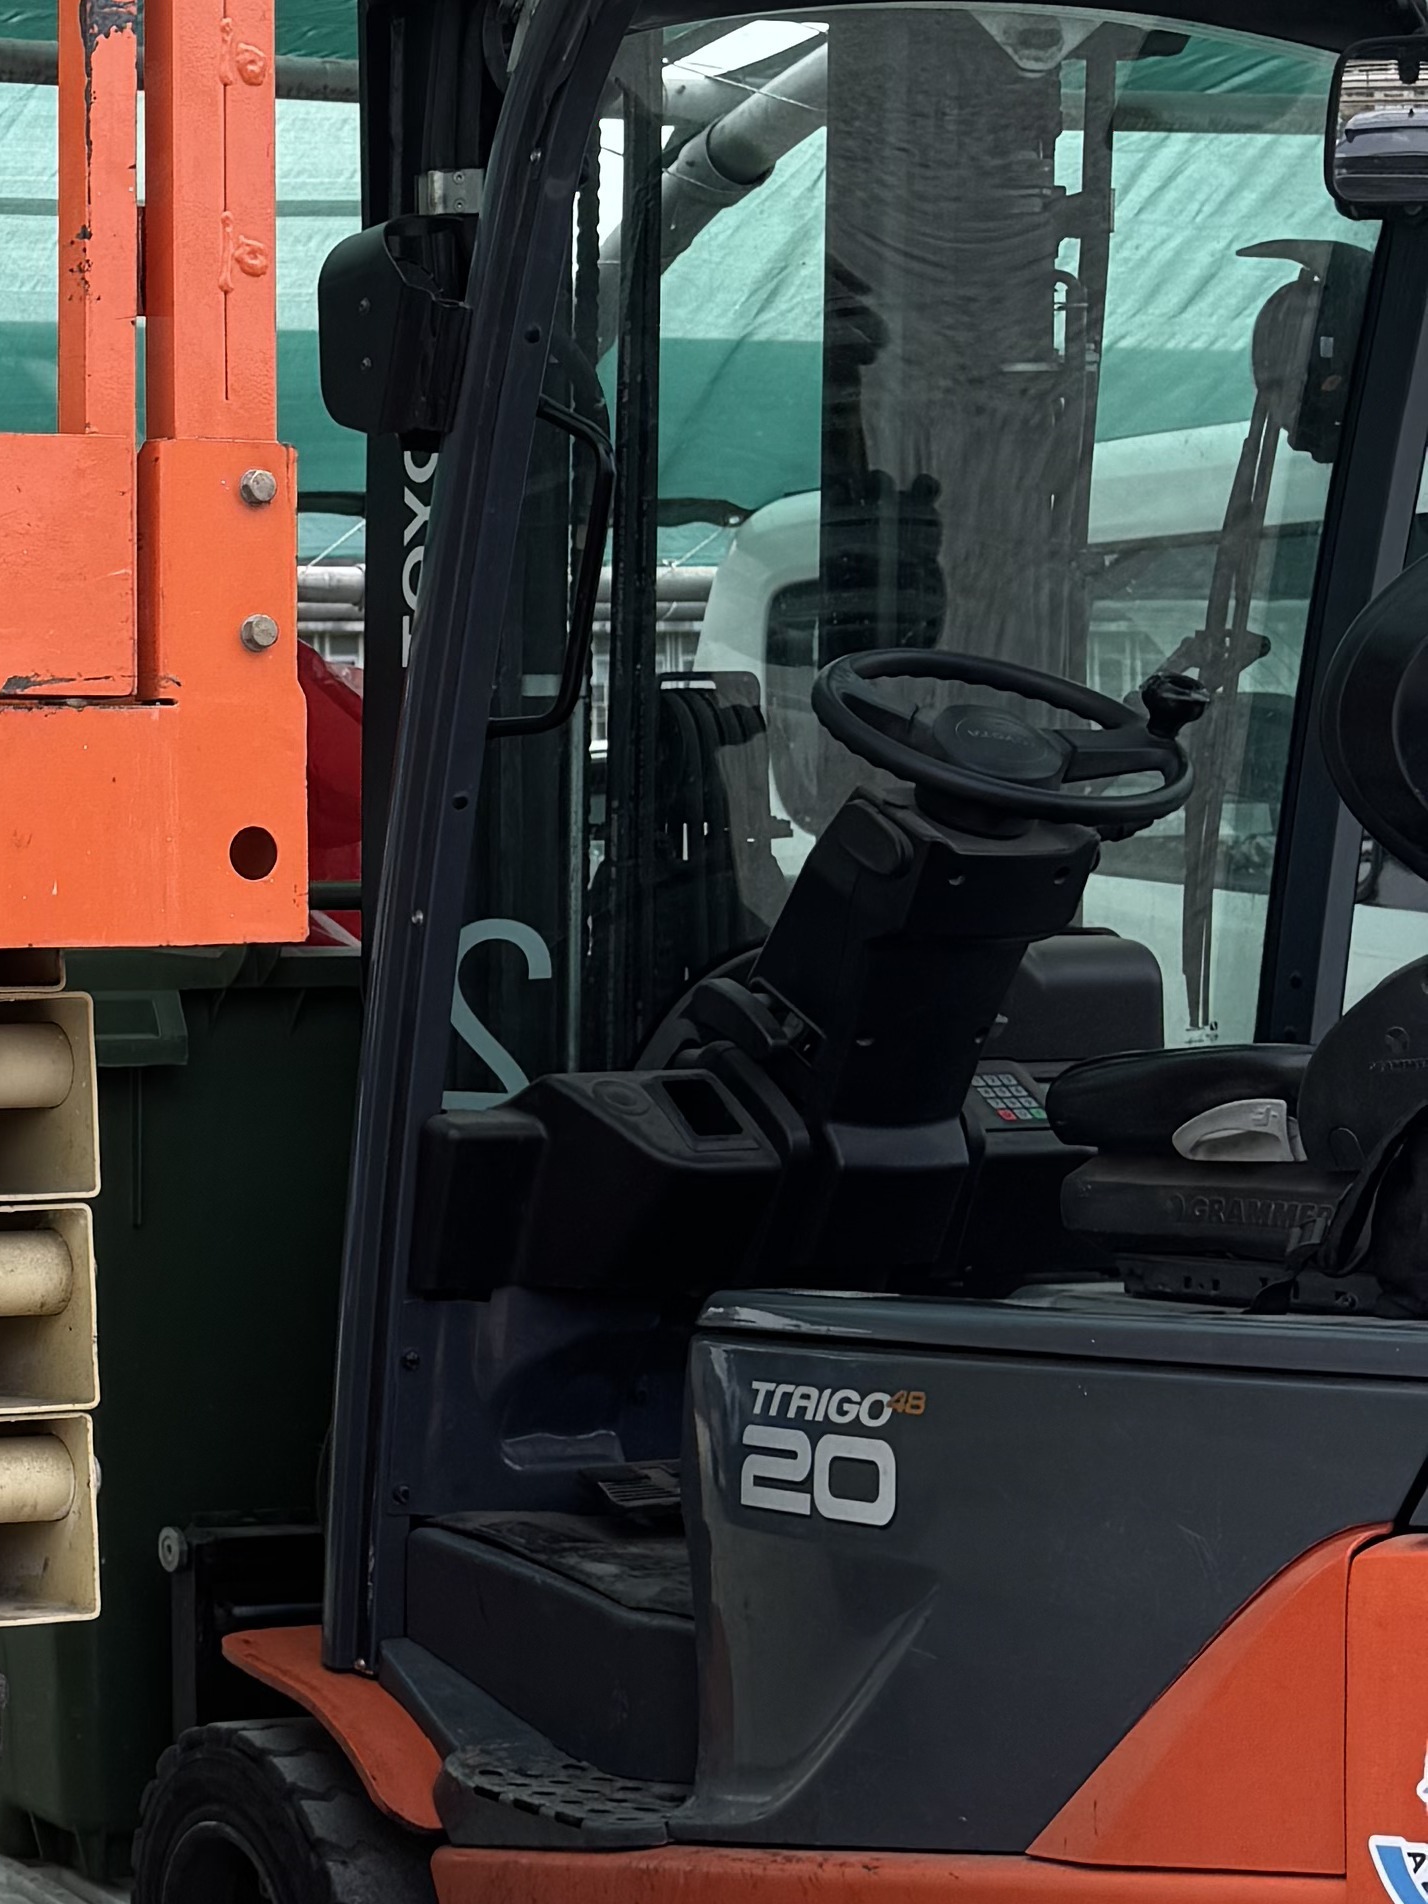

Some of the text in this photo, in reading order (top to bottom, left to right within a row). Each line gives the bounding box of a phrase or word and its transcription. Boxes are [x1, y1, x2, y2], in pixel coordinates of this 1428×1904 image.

[751, 1380, 926, 1427] TRAIGO 48
[740, 1423, 896, 1526] 20
